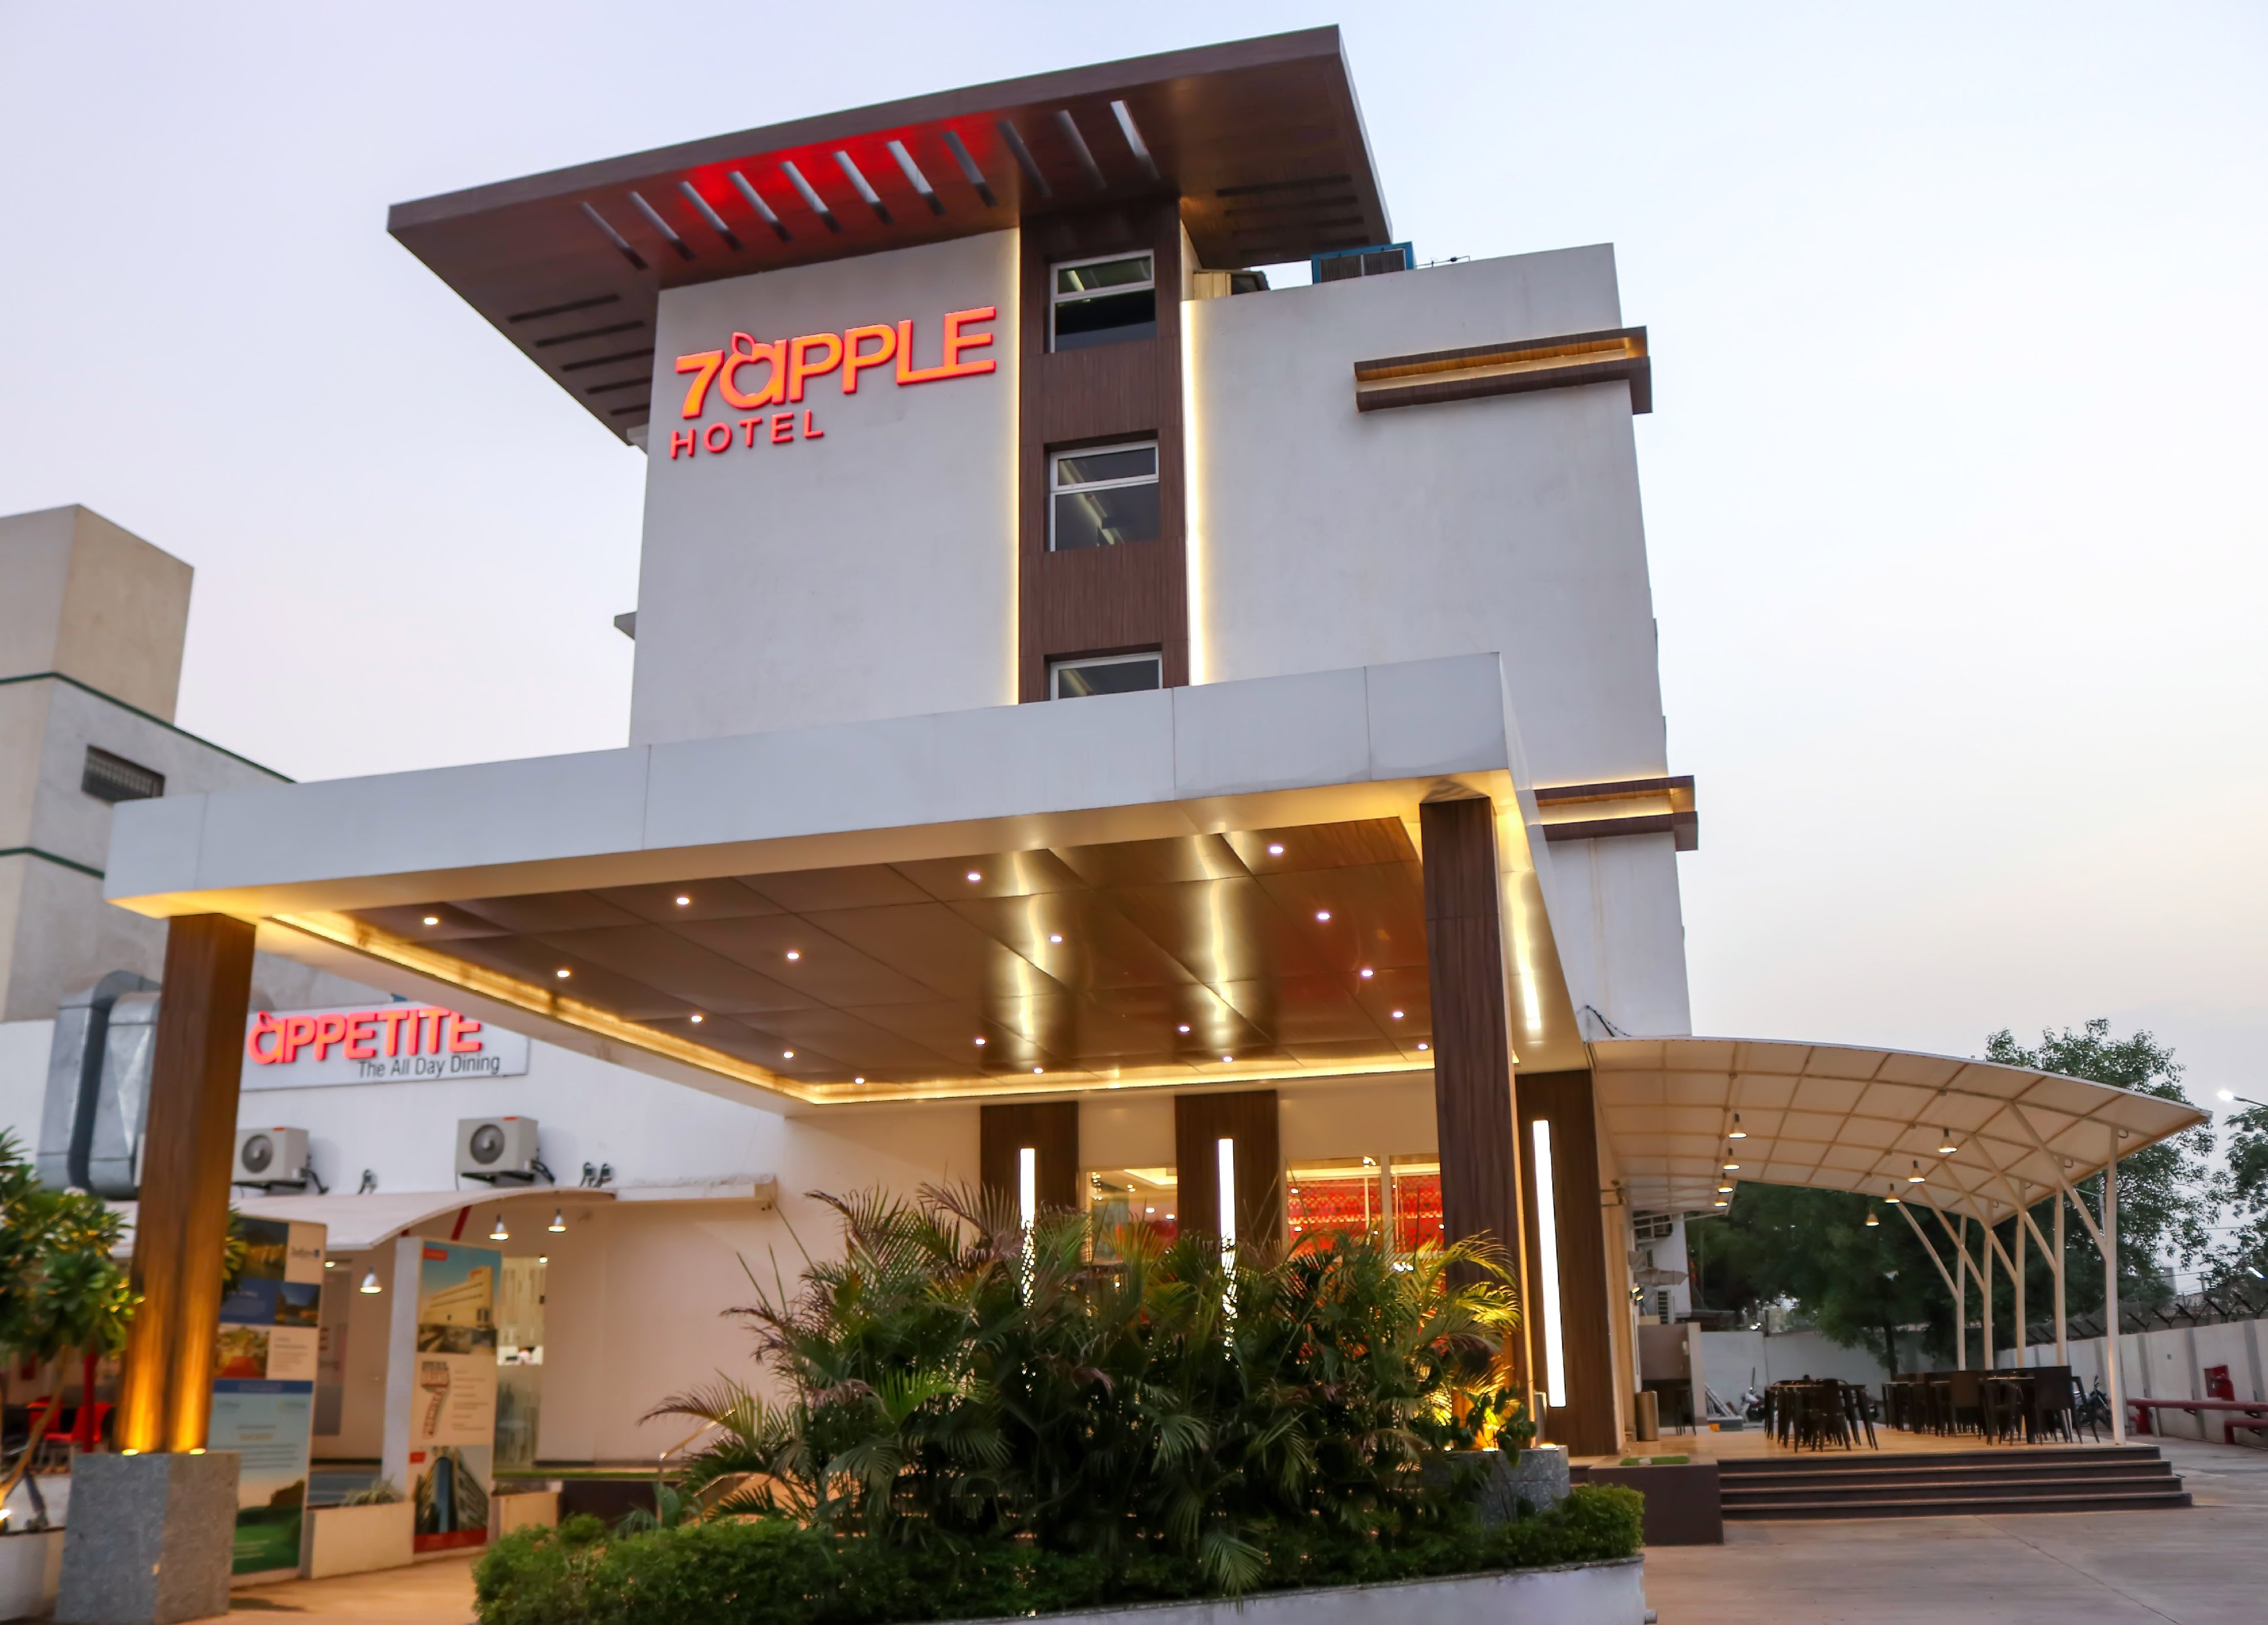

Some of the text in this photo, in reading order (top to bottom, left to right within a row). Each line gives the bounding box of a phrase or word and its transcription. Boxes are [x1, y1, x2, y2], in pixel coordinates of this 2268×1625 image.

[670, 409, 824, 460] HOTEL
[358, 1055, 500, 1078] The All Day Dining
